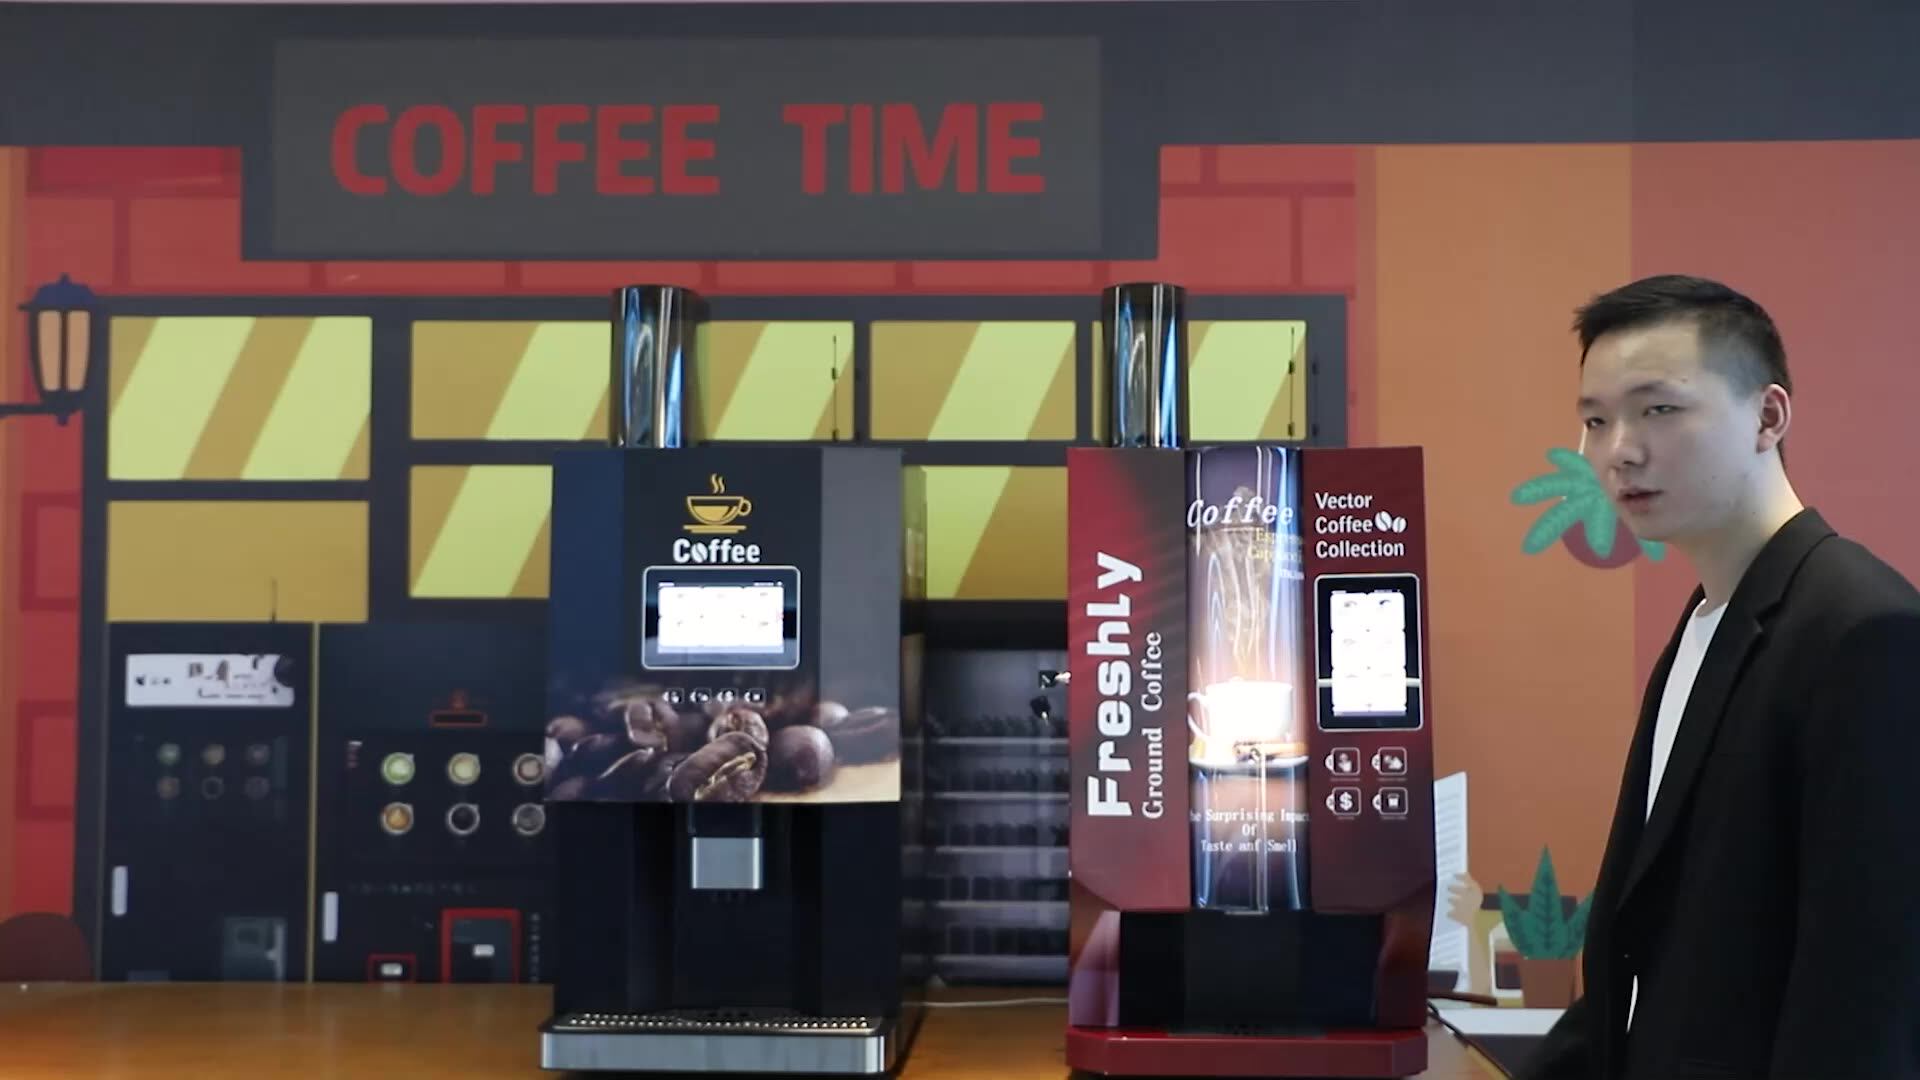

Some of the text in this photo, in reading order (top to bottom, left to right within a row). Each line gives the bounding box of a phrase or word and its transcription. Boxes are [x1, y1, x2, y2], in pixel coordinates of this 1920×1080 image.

[330, 103, 1046, 196] COFFEE TIME
[1315, 492, 1373, 509] Vector
[1187, 495, 1294, 527] Coffee
[1315, 515, 1373, 534] Coffee
[672, 538, 761, 564] Coffee
[1315, 540, 1404, 558] Collection
[1140, 631, 1164, 819] Ground Coffee
[1206, 807, 1275, 823] Surprising
[1200, 838, 1233, 853] Taste
[1267, 838, 1297, 853] Smell
